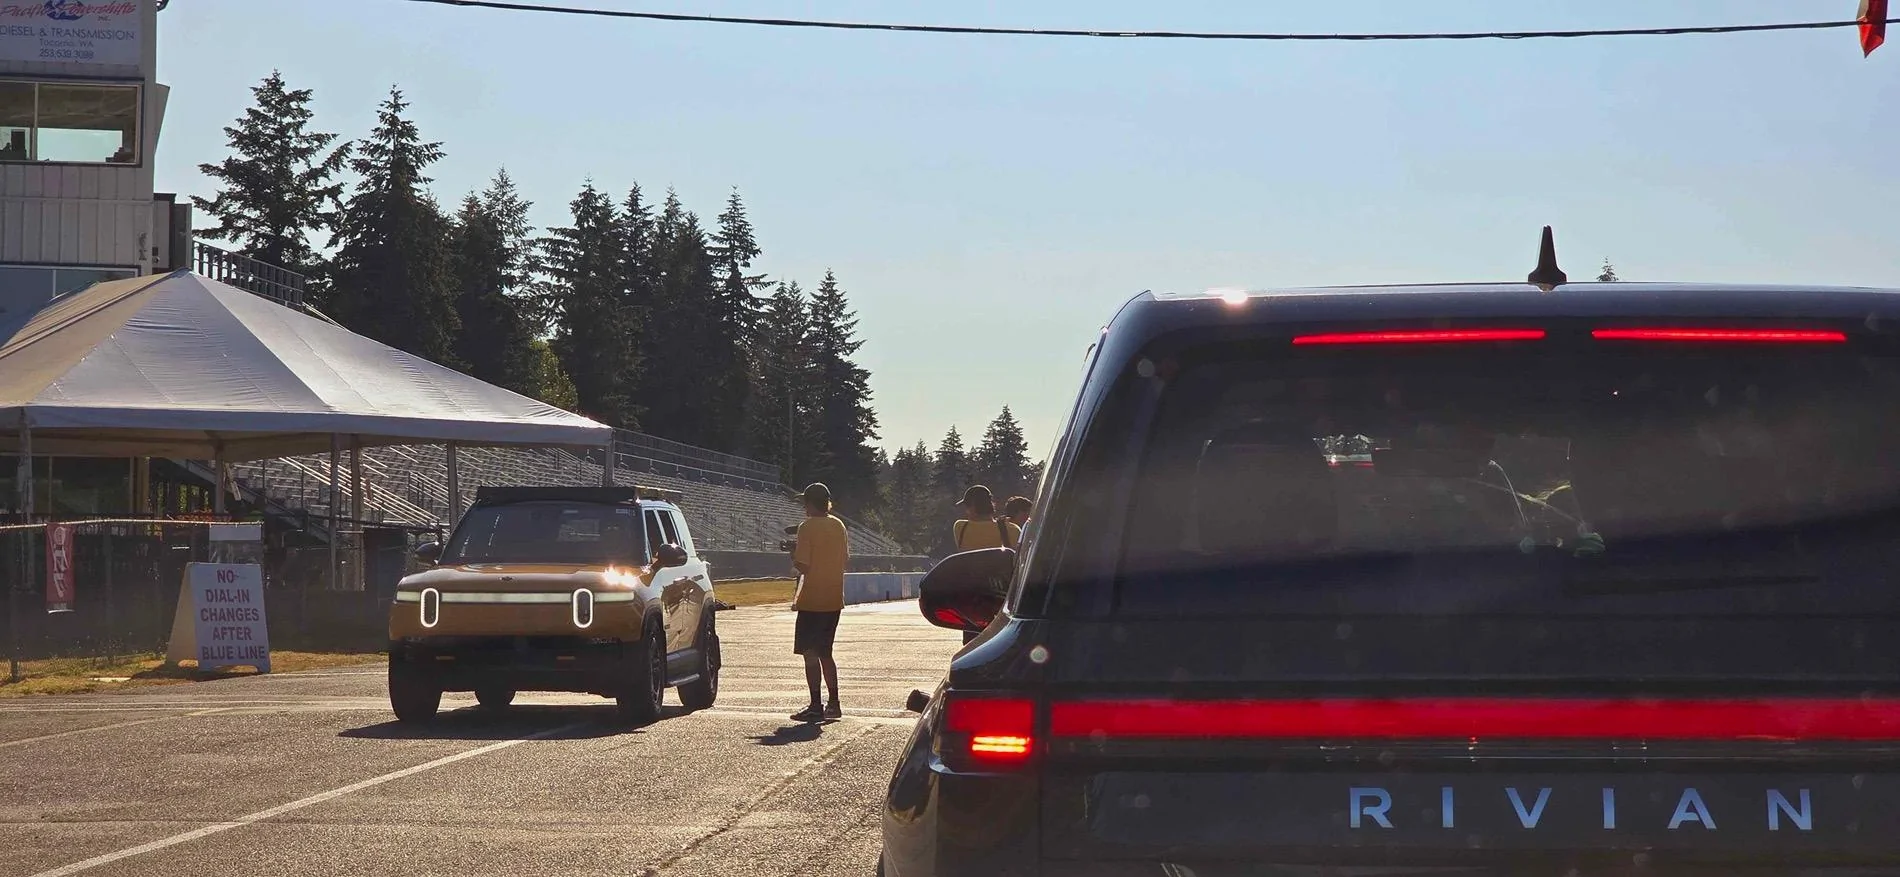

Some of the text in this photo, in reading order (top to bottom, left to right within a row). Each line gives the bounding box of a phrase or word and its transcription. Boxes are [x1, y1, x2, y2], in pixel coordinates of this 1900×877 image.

[0, 25, 135, 40] DIESEL & TRANSMISSION
[79, 40, 94, 48] WA
[205, 589, 250, 603] DIAL-IN
[200, 608, 259, 621] CHANGES
[213, 627, 252, 640] AFTER
[202, 646, 265, 660] BLUE LINE
[1349, 787, 1813, 831] RIVIAN
